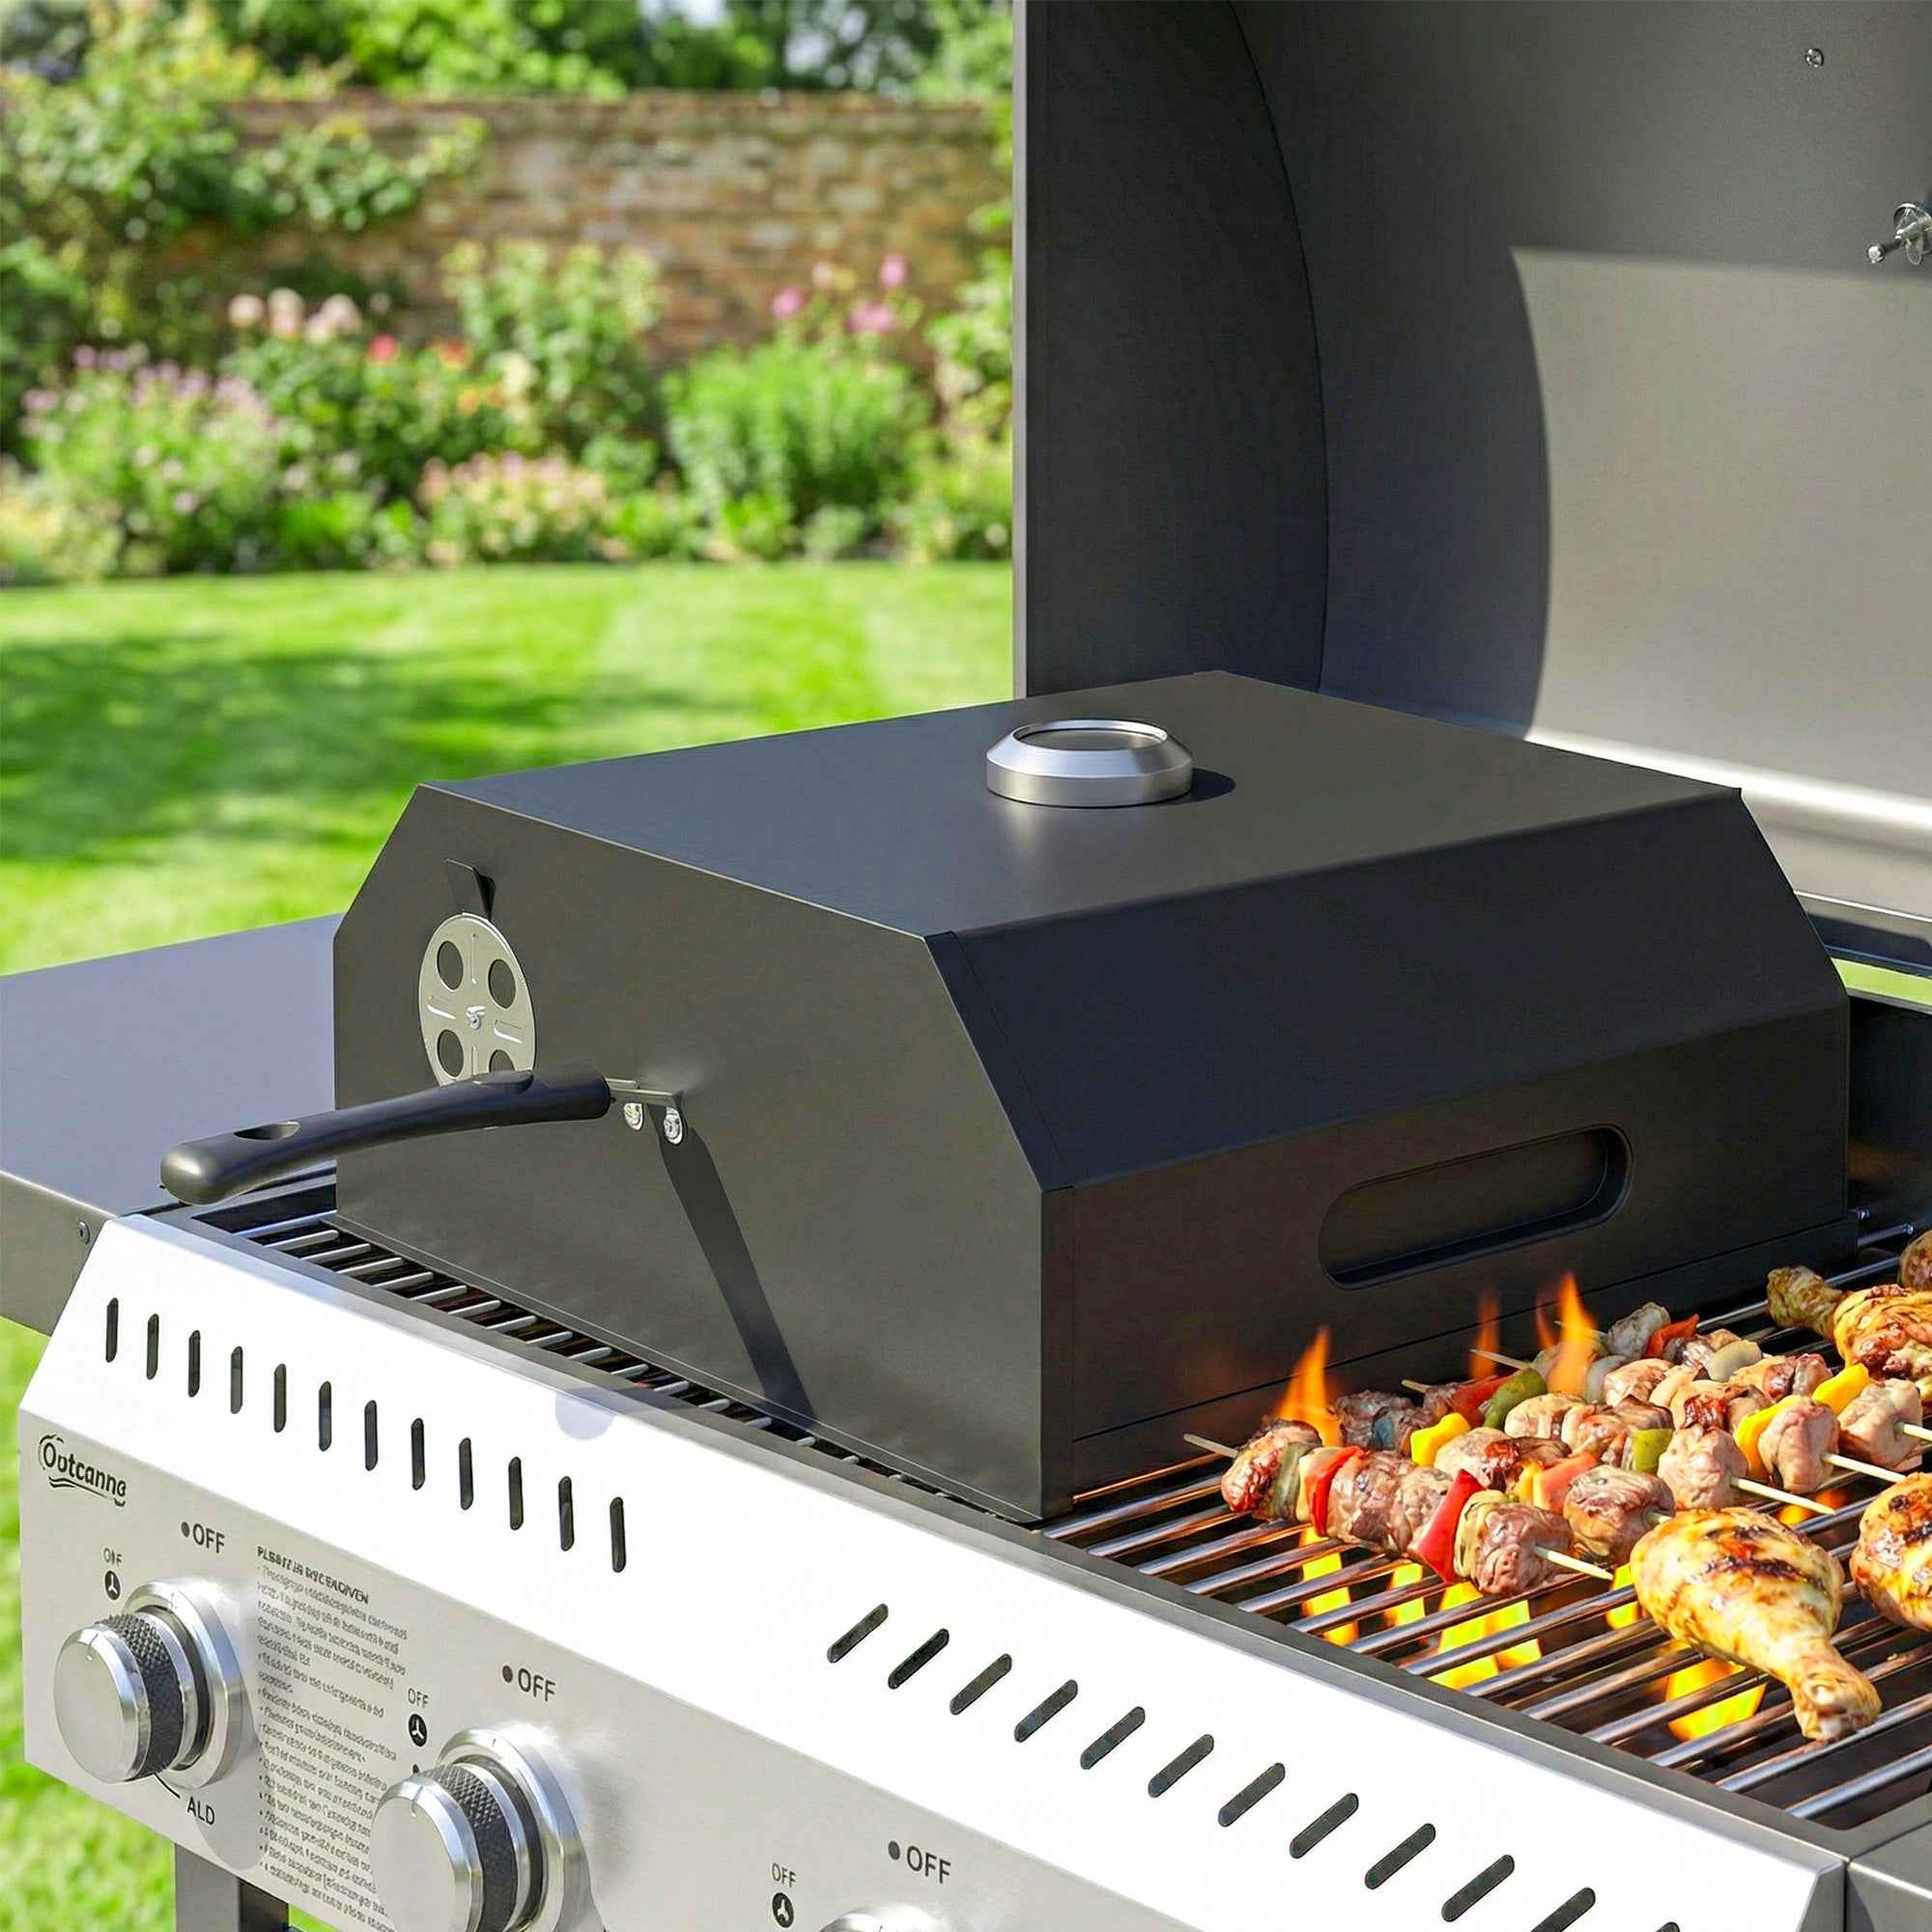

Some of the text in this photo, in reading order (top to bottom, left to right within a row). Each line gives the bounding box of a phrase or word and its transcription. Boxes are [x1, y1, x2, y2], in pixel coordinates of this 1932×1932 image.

[193, 1523, 224, 1553] OFF
[408, 1689, 428, 1708] OFF
[518, 1668, 555, 1701] OFF
[186, 1797, 214, 1825] ALD
[773, 1863, 796, 1887] OFF
[907, 1846, 951, 1884] OFF
